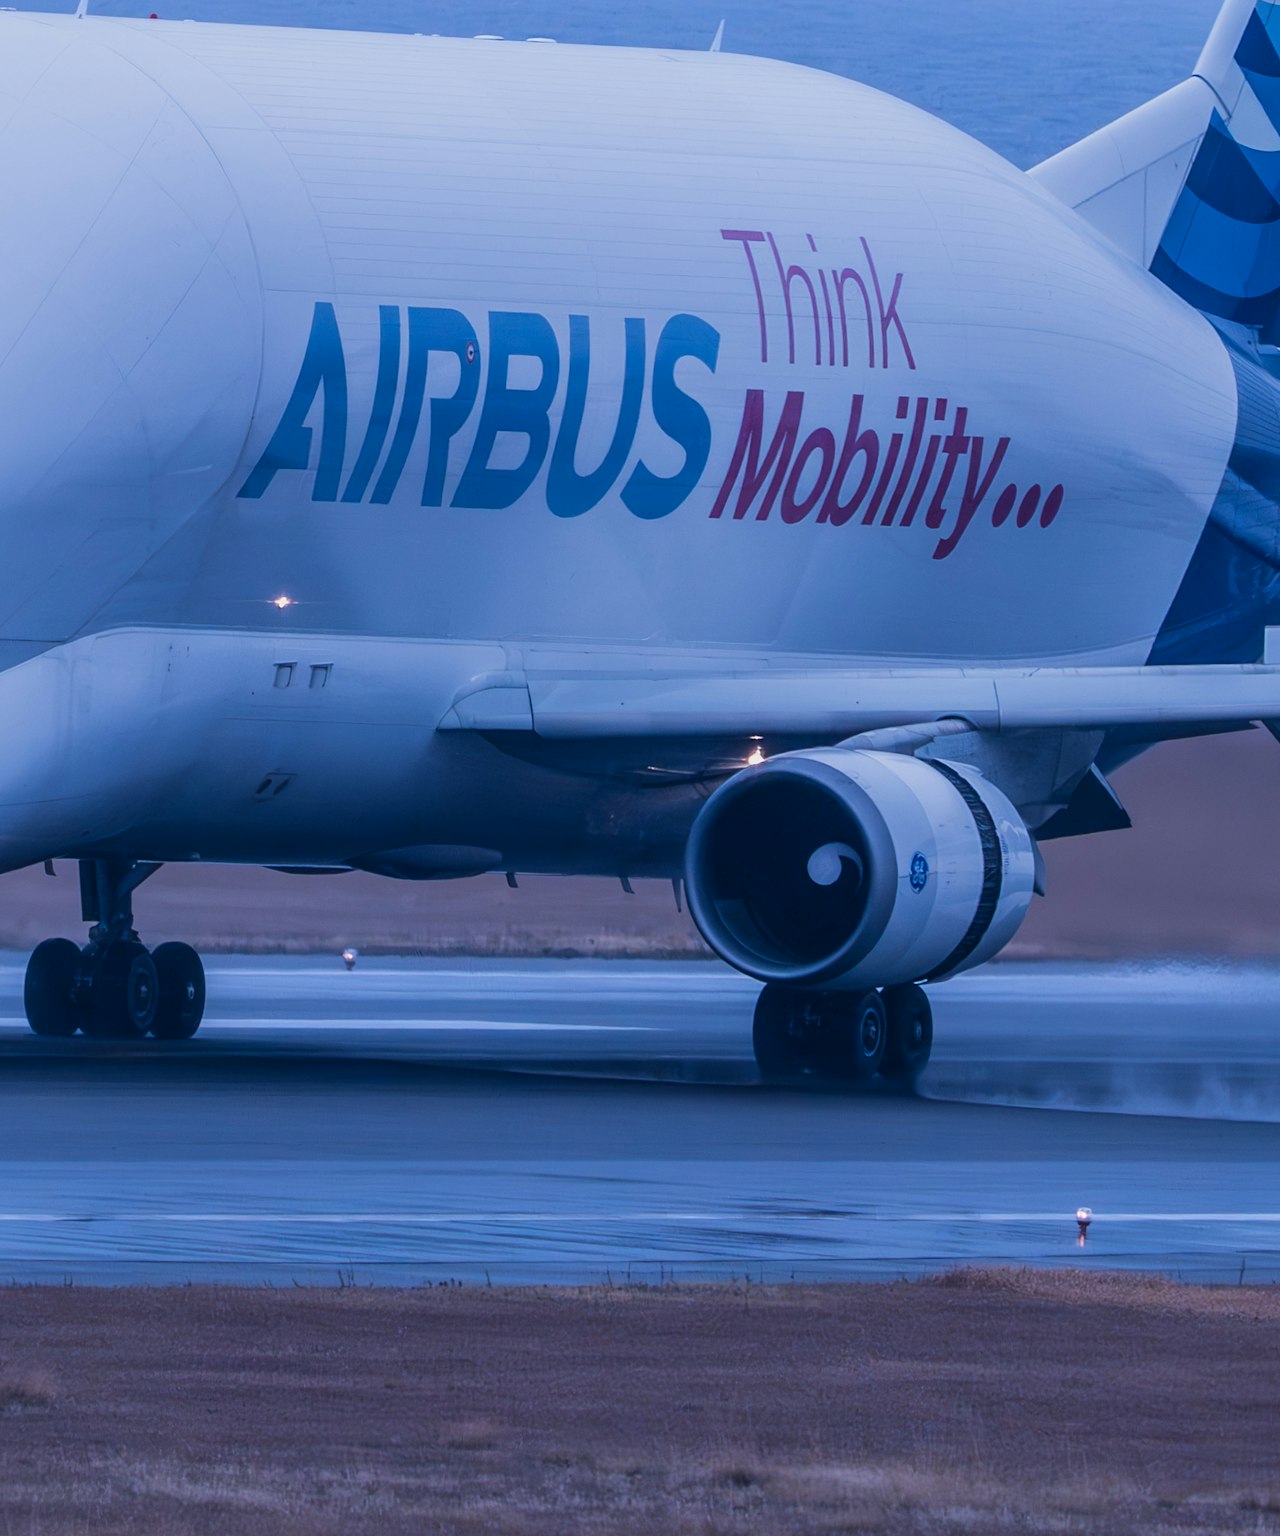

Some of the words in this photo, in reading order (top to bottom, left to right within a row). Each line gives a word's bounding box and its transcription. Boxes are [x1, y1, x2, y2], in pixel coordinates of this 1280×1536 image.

[720, 229, 917, 370] Think
[237, 302, 720, 519] AIRBUS
[709, 388, 1065, 560] Mobility...
